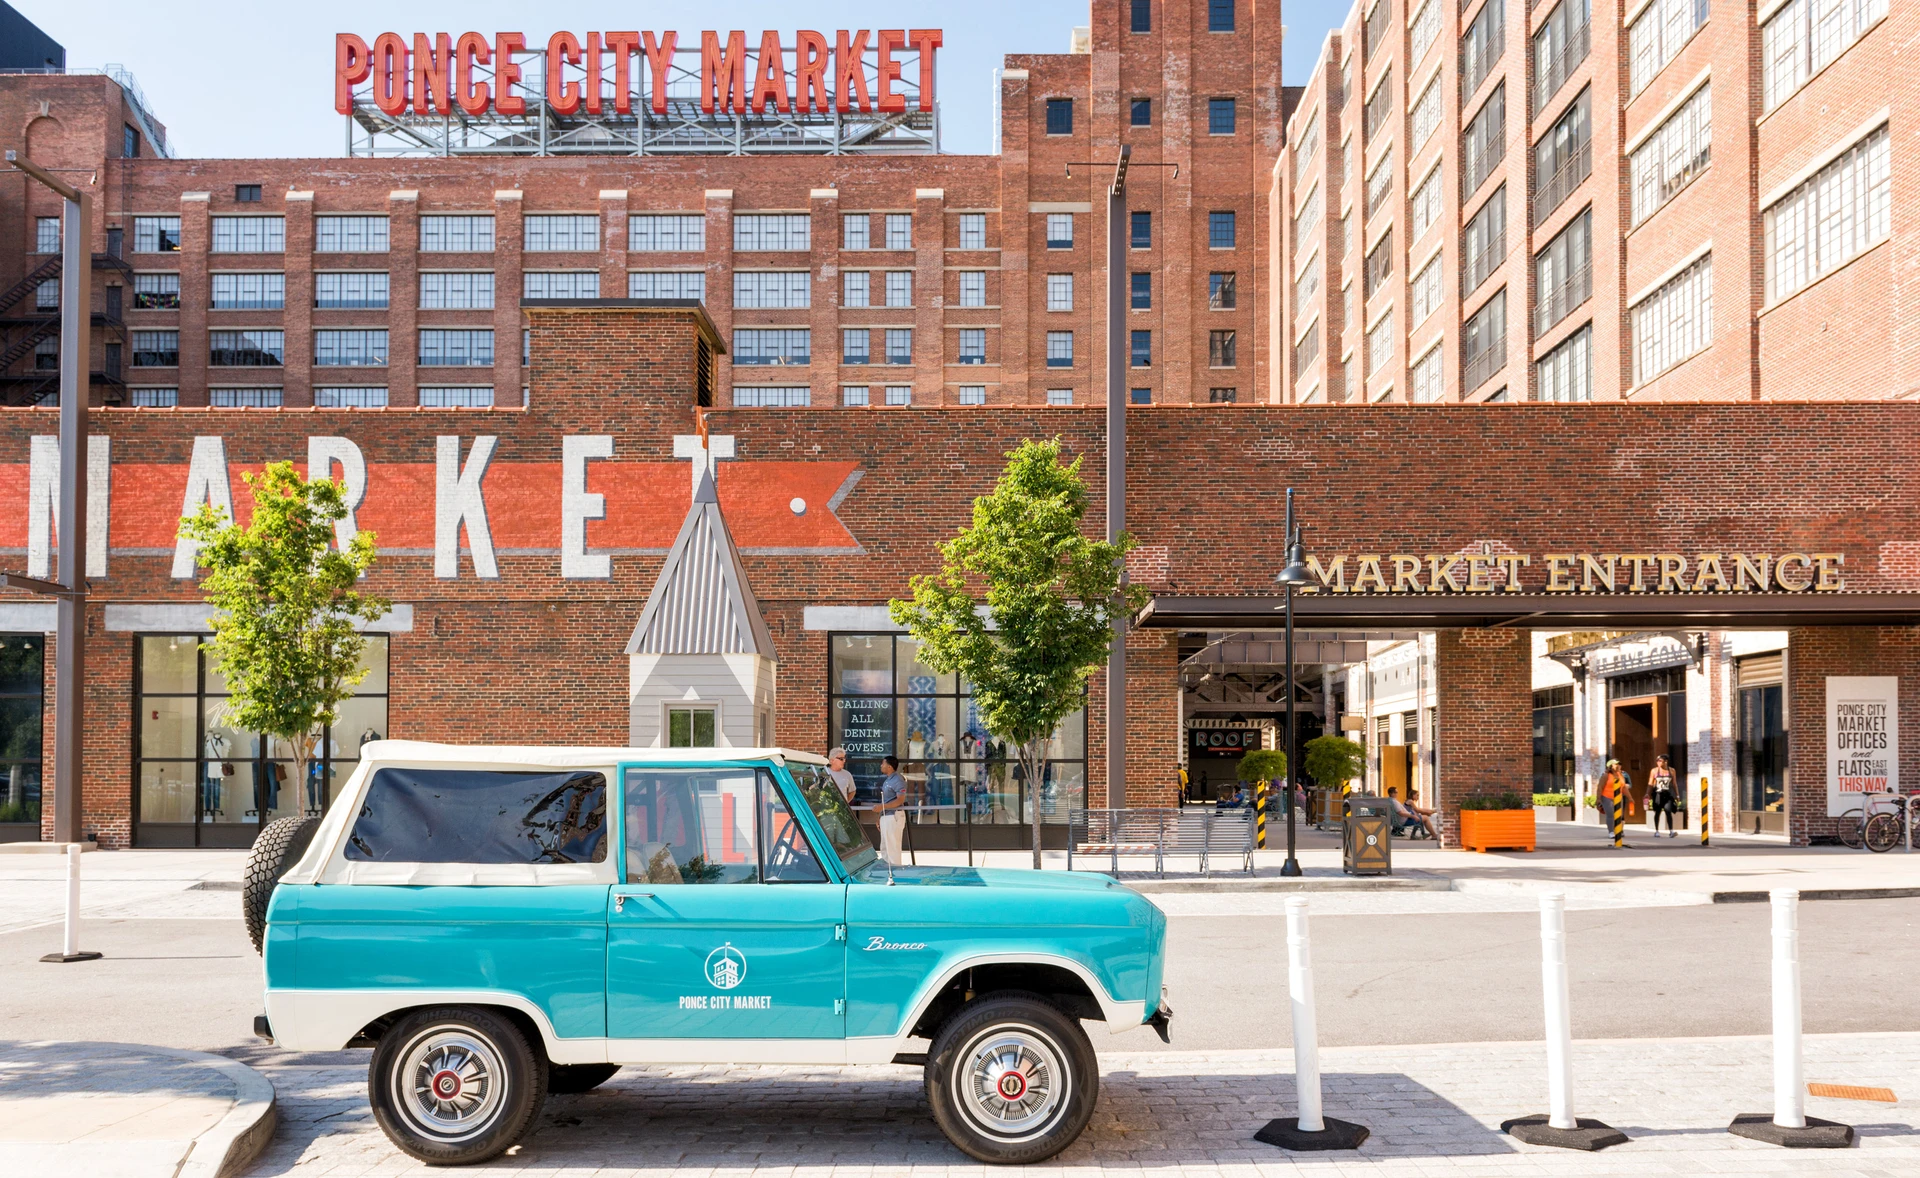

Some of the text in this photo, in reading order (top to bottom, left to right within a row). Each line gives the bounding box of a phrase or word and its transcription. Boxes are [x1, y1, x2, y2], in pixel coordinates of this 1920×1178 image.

[335, 29, 943, 115] PONCE CITY MARKET
[1302, 553, 1845, 592] MARKET ENTRANCE
[836, 700, 889, 709] CALLING
[1837, 704, 1887, 716] PONCE CITY
[851, 714, 874, 723] ALL
[1837, 716, 1887, 731] MARKET
[844, 728, 881, 738] DENIM
[1195, 731, 1255, 747] ROOF
[841, 743, 884, 752] LOVERS
[1837, 732, 1887, 750] OFFICES
[1850, 750, 1874, 758] and
[1837, 760, 1871, 776] FLATS
[1872, 760, 1887, 768] EAST
[1838, 777, 1888, 792] THIS WAY
[862, 936, 928, 951] Bronco
[679, 995, 771, 1009] PONCE CITY MARKET
